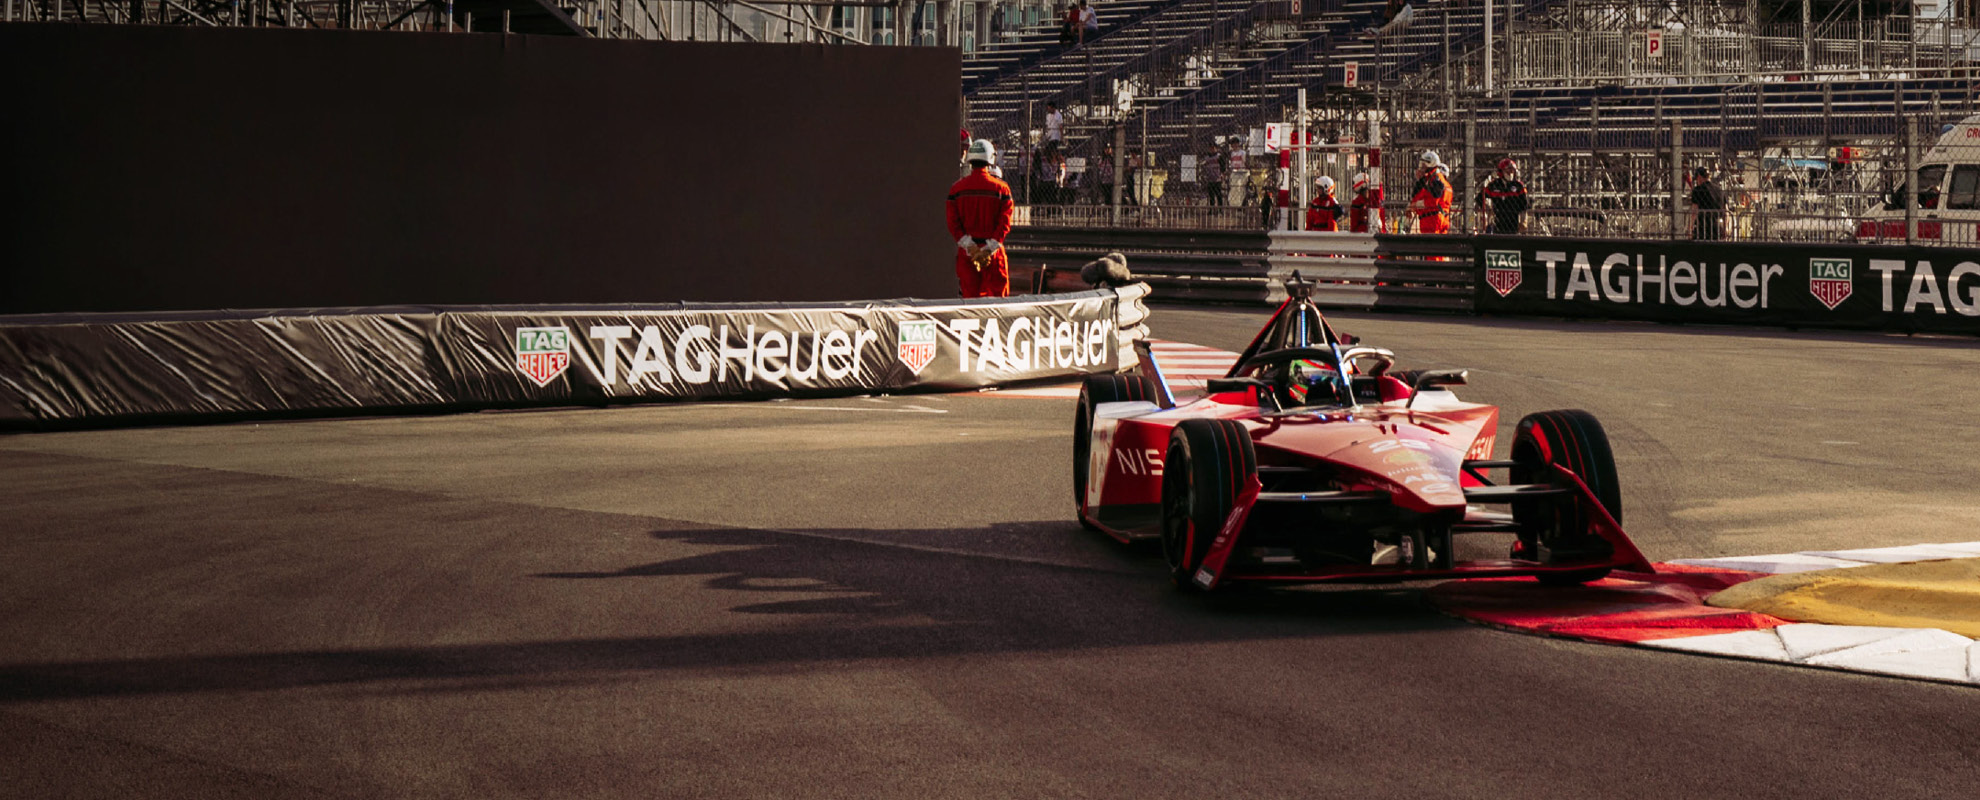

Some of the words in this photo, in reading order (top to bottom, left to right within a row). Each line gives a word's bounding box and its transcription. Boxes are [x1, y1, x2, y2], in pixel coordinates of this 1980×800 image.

[1650, 39, 1659, 54] P
[1347, 70, 1355, 84] P
[1488, 254, 1518, 267] TAG
[1814, 262, 1848, 278] TAG
[1488, 271, 1520, 293] HEUER
[1812, 280, 1849, 305] HEUER
[521, 331, 566, 350] TAG
[902, 324, 934, 340] TAG
[900, 343, 934, 369] HEUER
[519, 353, 568, 381] HEUER
[1115, 447, 1165, 476] NIS
